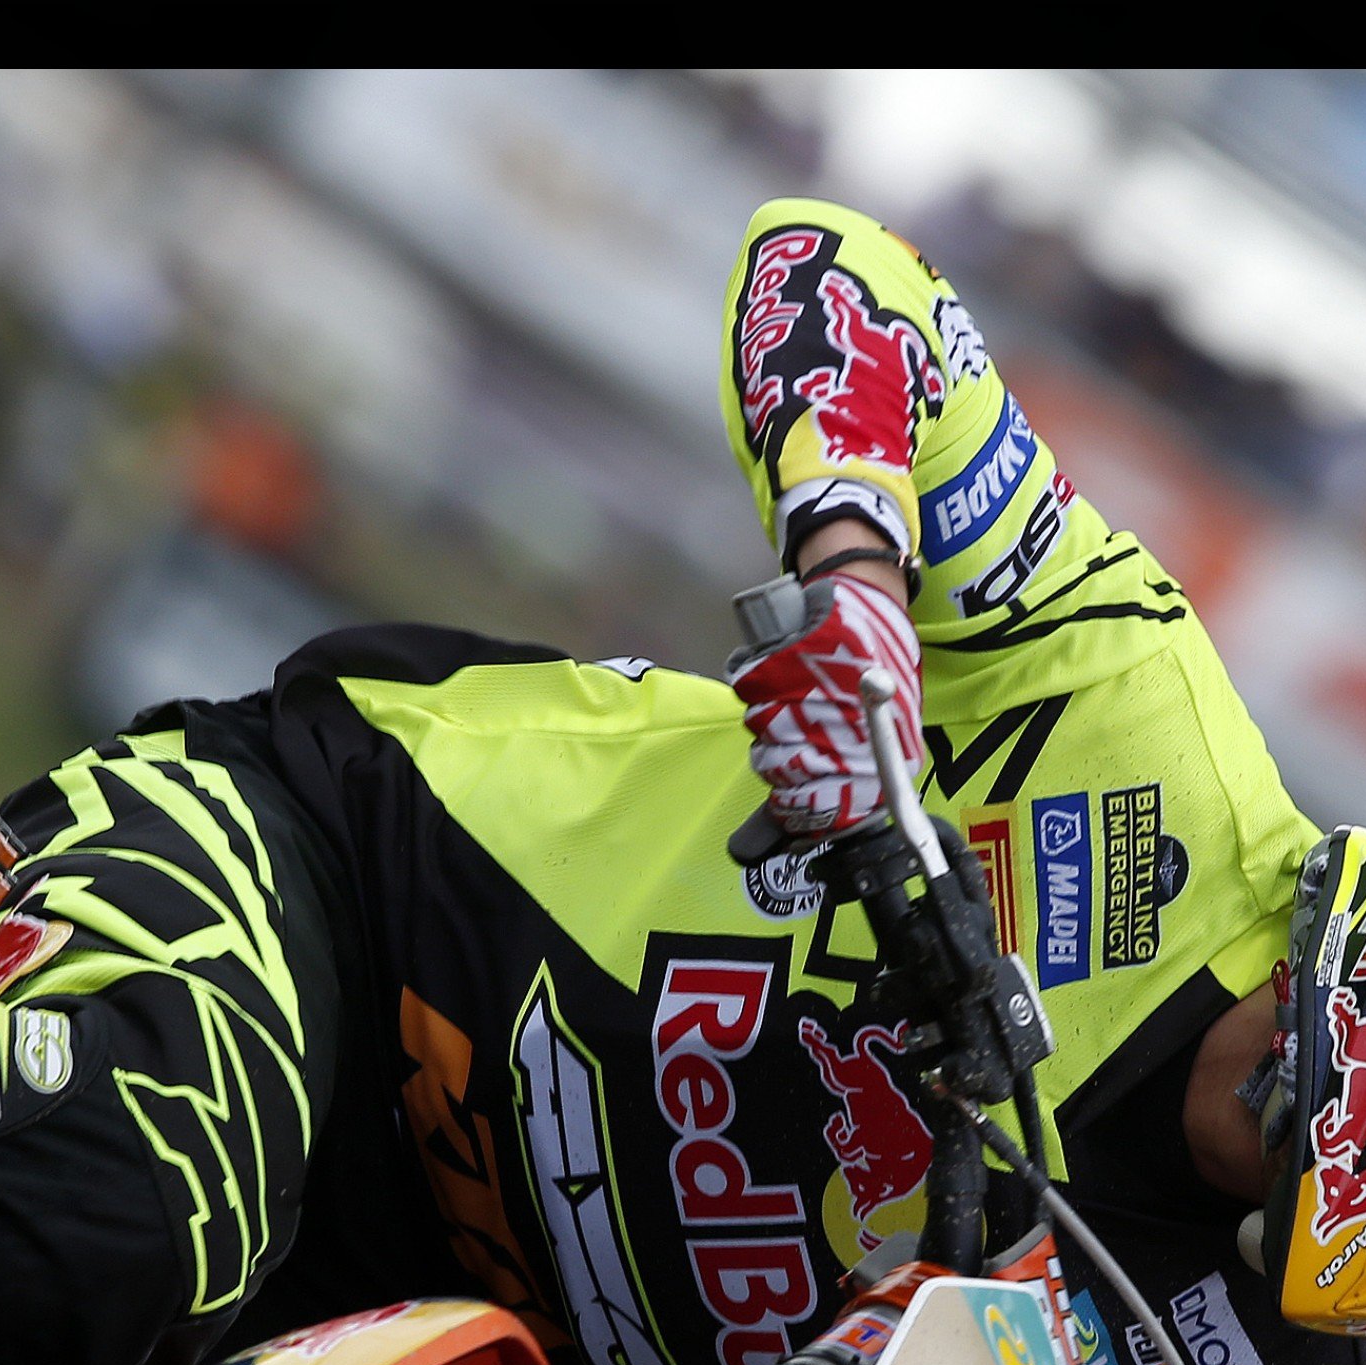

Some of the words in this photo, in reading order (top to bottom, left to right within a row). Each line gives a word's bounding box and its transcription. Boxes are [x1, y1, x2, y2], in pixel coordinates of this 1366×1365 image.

[744, 229, 825, 338] Red
[935, 432, 1027, 544] MAPEI
[1045, 862, 1080, 967] MAPEI
[1106, 796, 1127, 964] EMERGENCY
[1134, 789, 1156, 962] BREITLING
[654, 958, 807, 1227] Red
